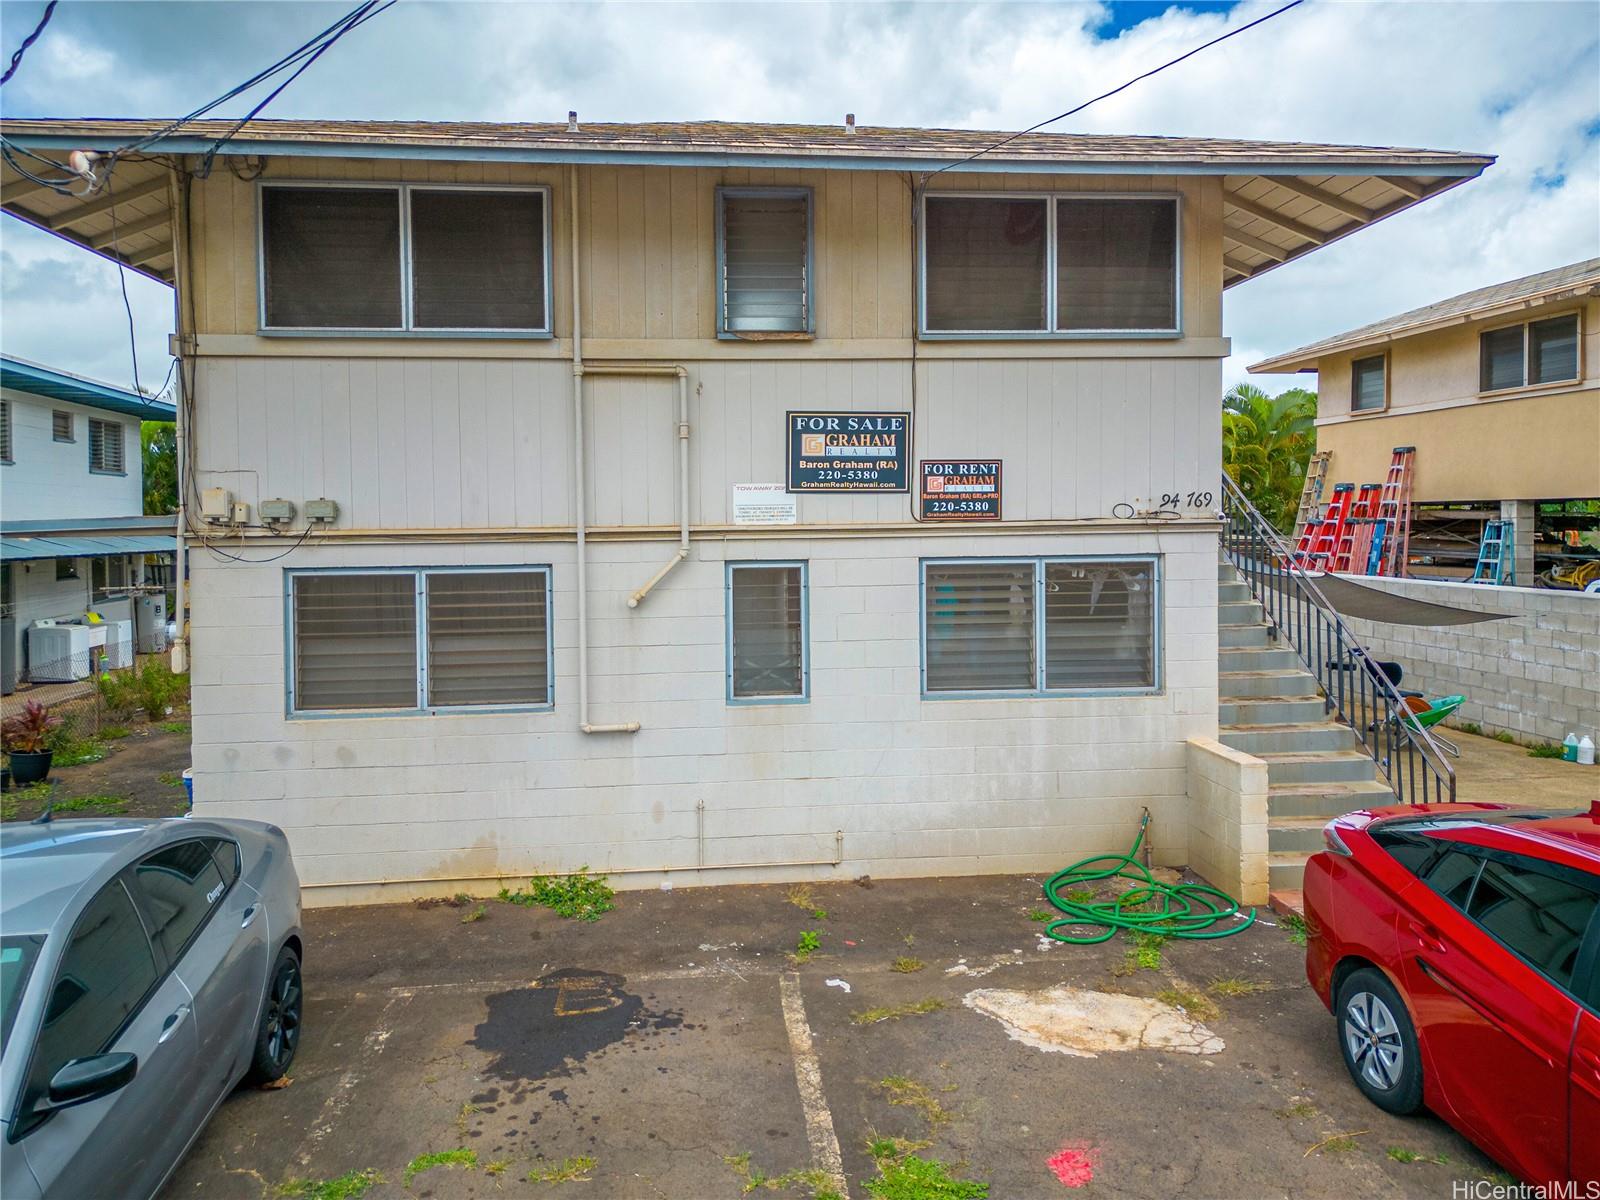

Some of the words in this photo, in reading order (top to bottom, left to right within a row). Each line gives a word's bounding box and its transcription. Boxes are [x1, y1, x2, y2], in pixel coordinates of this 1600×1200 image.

[796, 417, 840, 431] FOR
[848, 417, 903, 431] SALE
[826, 434, 896, 447] GRAHAM
[827, 447, 896, 455] REALTY
[799, 460, 830, 469] Baron
[833, 460, 873, 469] Graham
[876, 460, 898, 470] (RA)
[924, 464, 954, 475] FOR
[960, 463, 998, 475] RENT
[818, 470, 878, 479] 220-5380
[801, 481, 896, 489] GrahamRealtyHawaii.com
[944, 475, 994, 485] GRAHAM
[933, 501, 989, 511] 220-5380
[1159, 493, 1180, 509] 94
